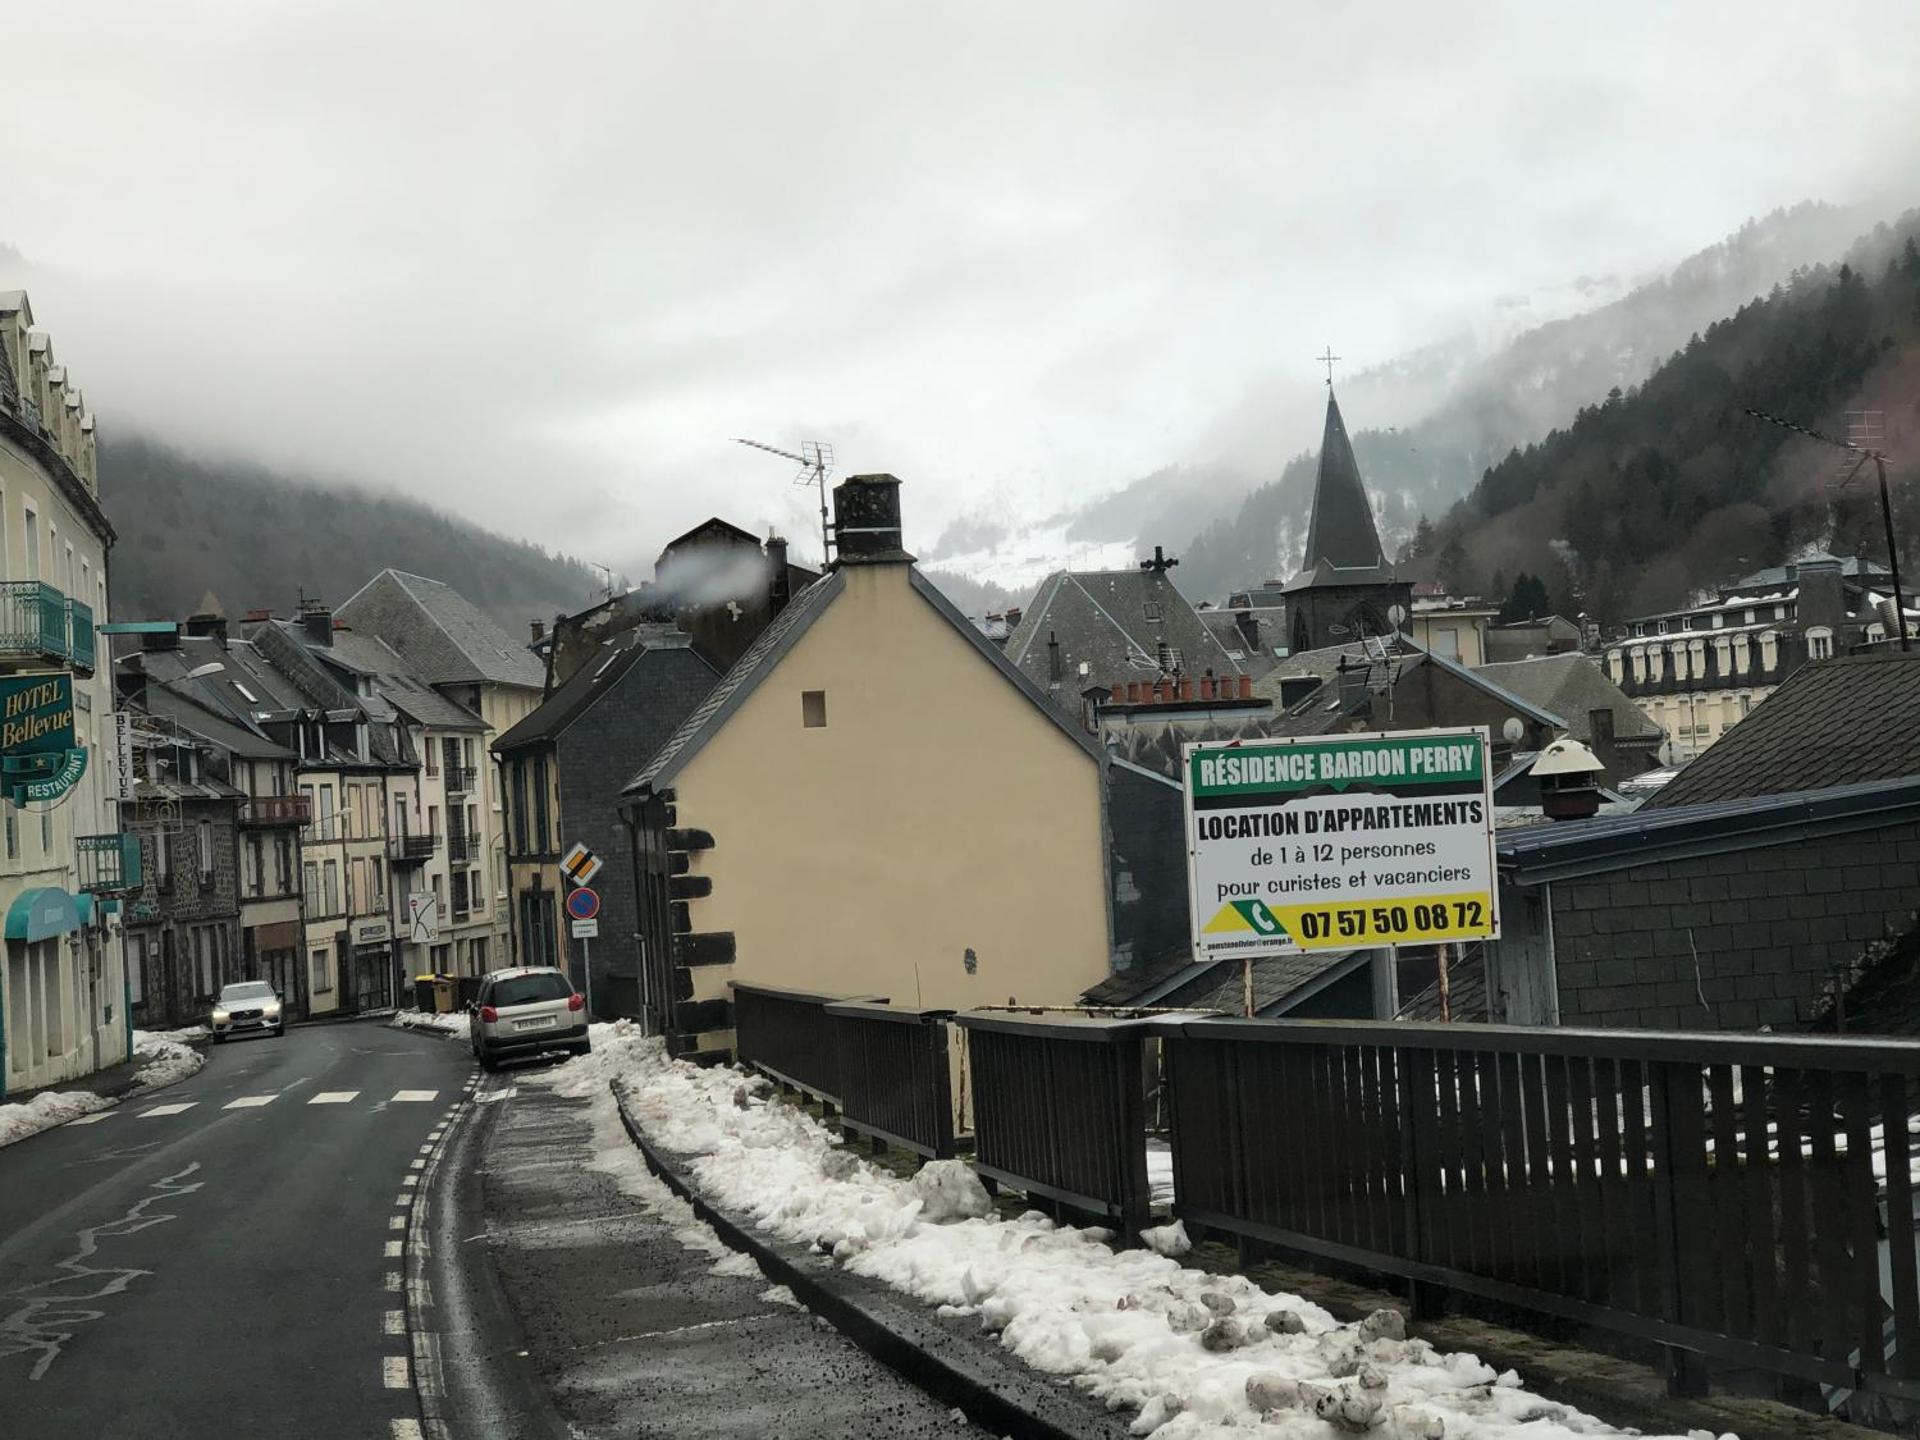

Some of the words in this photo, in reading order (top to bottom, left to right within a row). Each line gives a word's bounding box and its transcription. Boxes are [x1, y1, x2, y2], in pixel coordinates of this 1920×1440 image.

[5, 680, 64, 718] HOTEL
[1, 709, 72, 749] Bellevue
[27, 753, 82, 797] RESTAURANT
[115, 715, 129, 798] BELLEVUE
[1200, 753, 1316, 787] RÉSIDENCE
[1319, 748, 1405, 779] BARDON
[1410, 744, 1474, 774] PERRY
[1198, 811, 1299, 841] LOCATION
[1304, 800, 1483, 834] D'APPARTEMENTS
[1251, 847, 1273, 866] de
[1280, 847, 1287, 864] 1
[1295, 845, 1305, 863] à
[1313, 844, 1334, 862] 12
[1341, 841, 1436, 866] personnes
[1217, 882, 1260, 902] pour
[1268, 873, 1341, 893] curistes
[1349, 870, 1367, 888] et
[1374, 865, 1471, 886] vacanciers
[1301, 912, 1331, 939] 07
[1337, 909, 1366, 936] 57
[1372, 906, 1408, 934] 50
[1414, 904, 1449, 931] 08
[1453, 901, 1483, 928] 72
